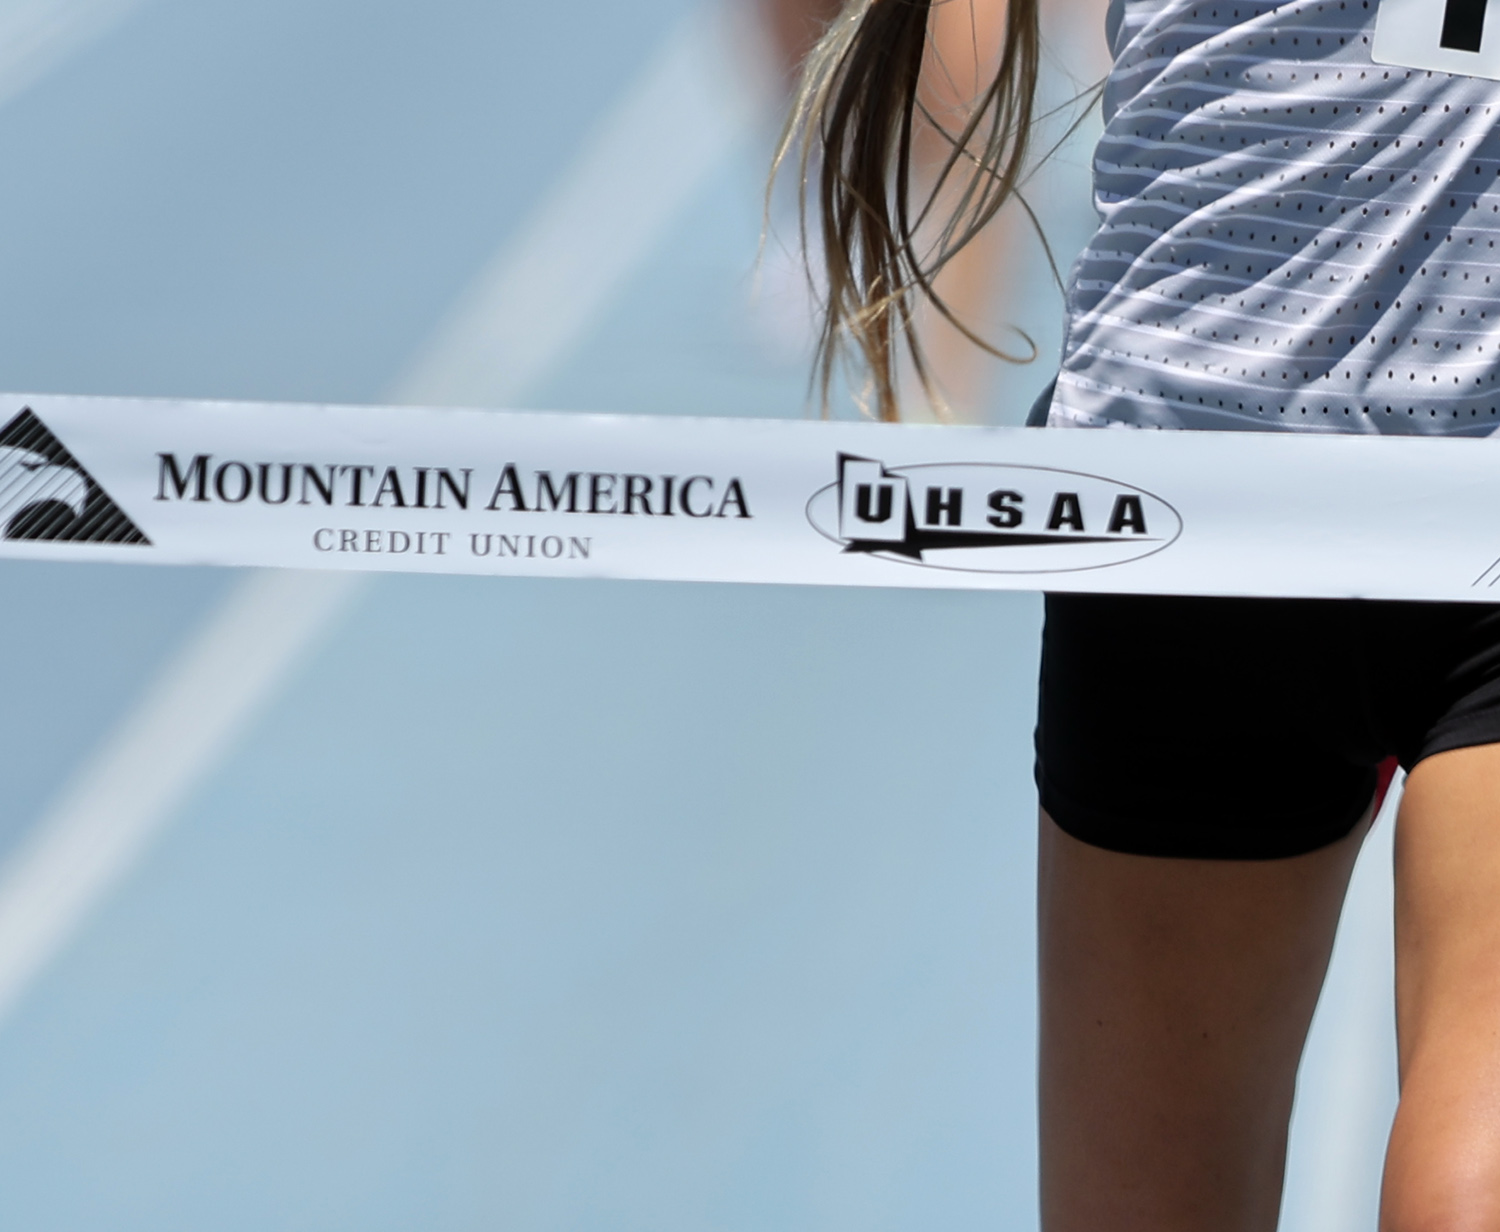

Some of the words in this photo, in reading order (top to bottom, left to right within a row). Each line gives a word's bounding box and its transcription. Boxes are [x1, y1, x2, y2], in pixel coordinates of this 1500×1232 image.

[154, 452, 473, 509] MOUNTAIN
[486, 463, 753, 520] AMERICA
[854, 482, 1148, 535] UHSAA
[312, 527, 452, 556] CREDIT
[469, 532, 593, 560] UNION
